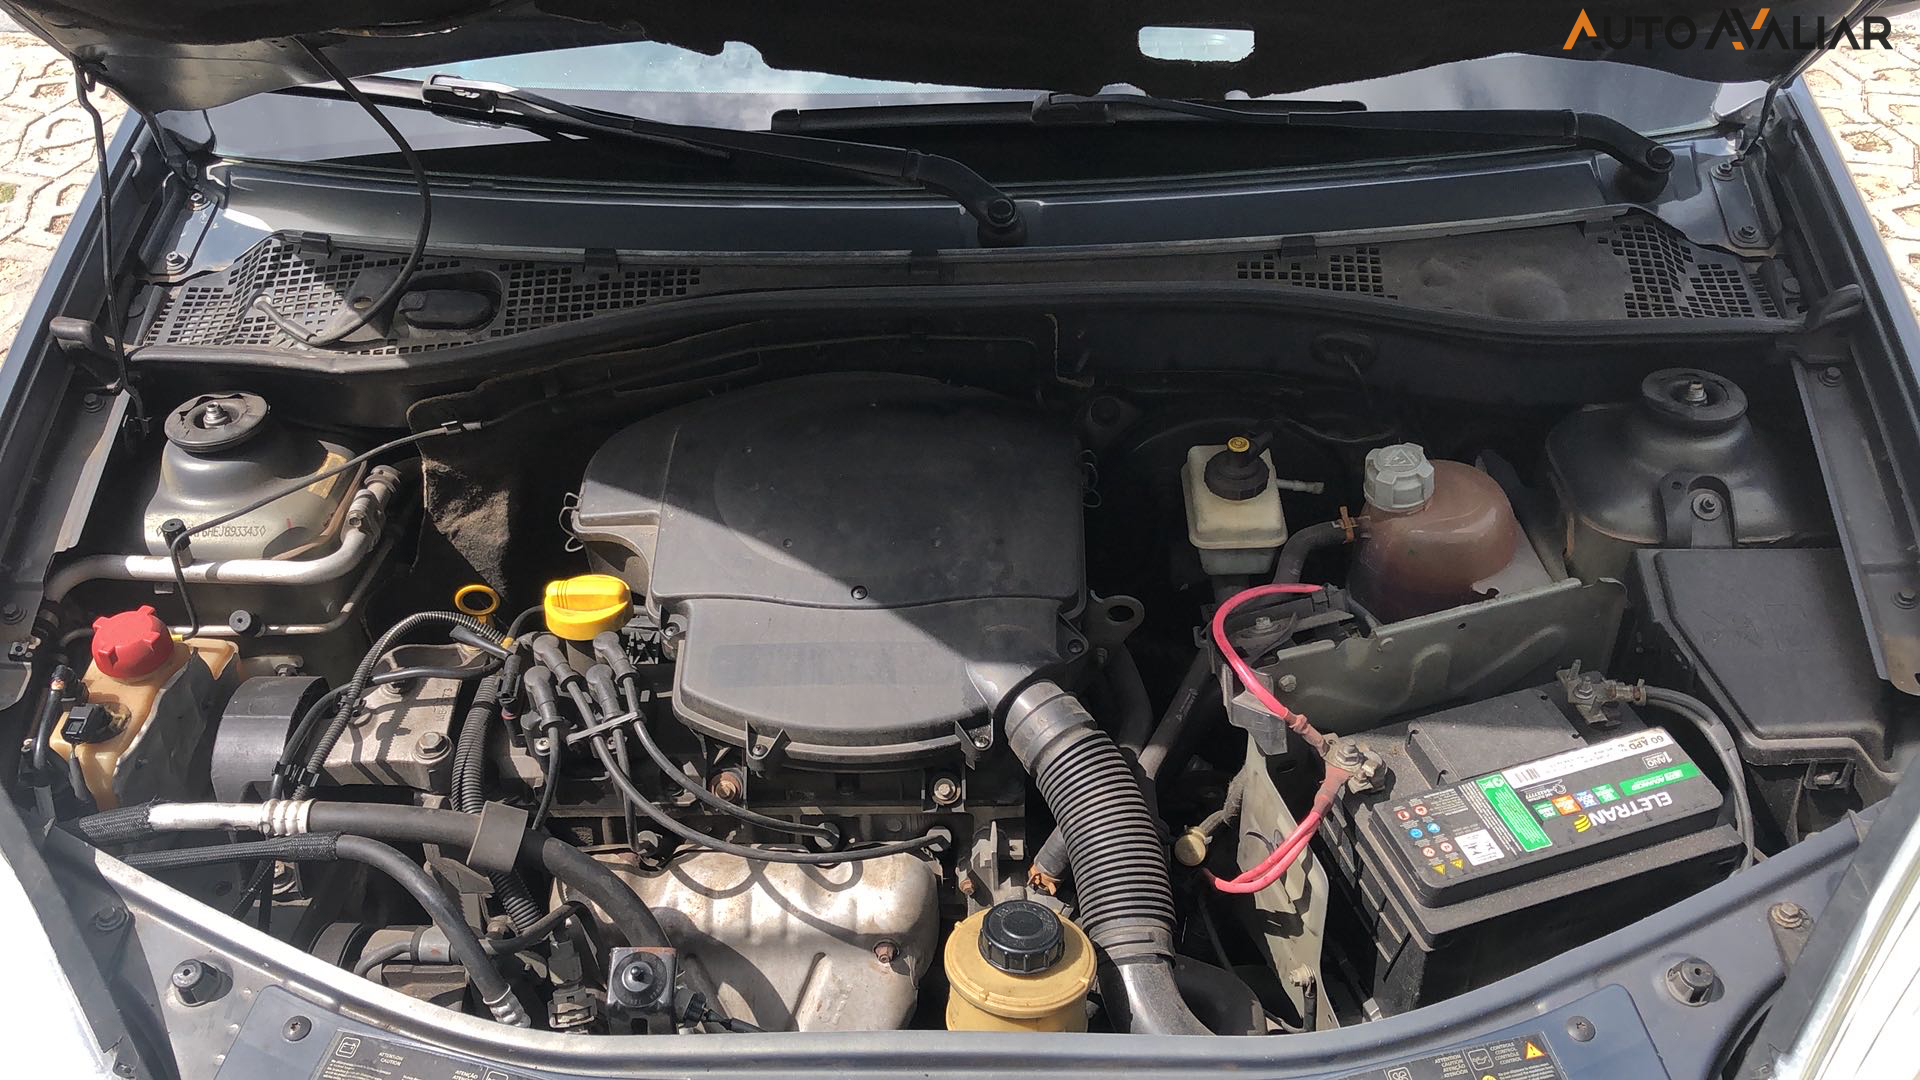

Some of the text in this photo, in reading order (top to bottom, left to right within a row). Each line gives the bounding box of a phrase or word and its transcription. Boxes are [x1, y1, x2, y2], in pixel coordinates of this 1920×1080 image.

[1628, 739, 1649, 750] APD
[1650, 735, 1665, 744] 60
[1587, 791, 1673, 827] ELETRAN
[380, 1058, 401, 1067] CAUTION
